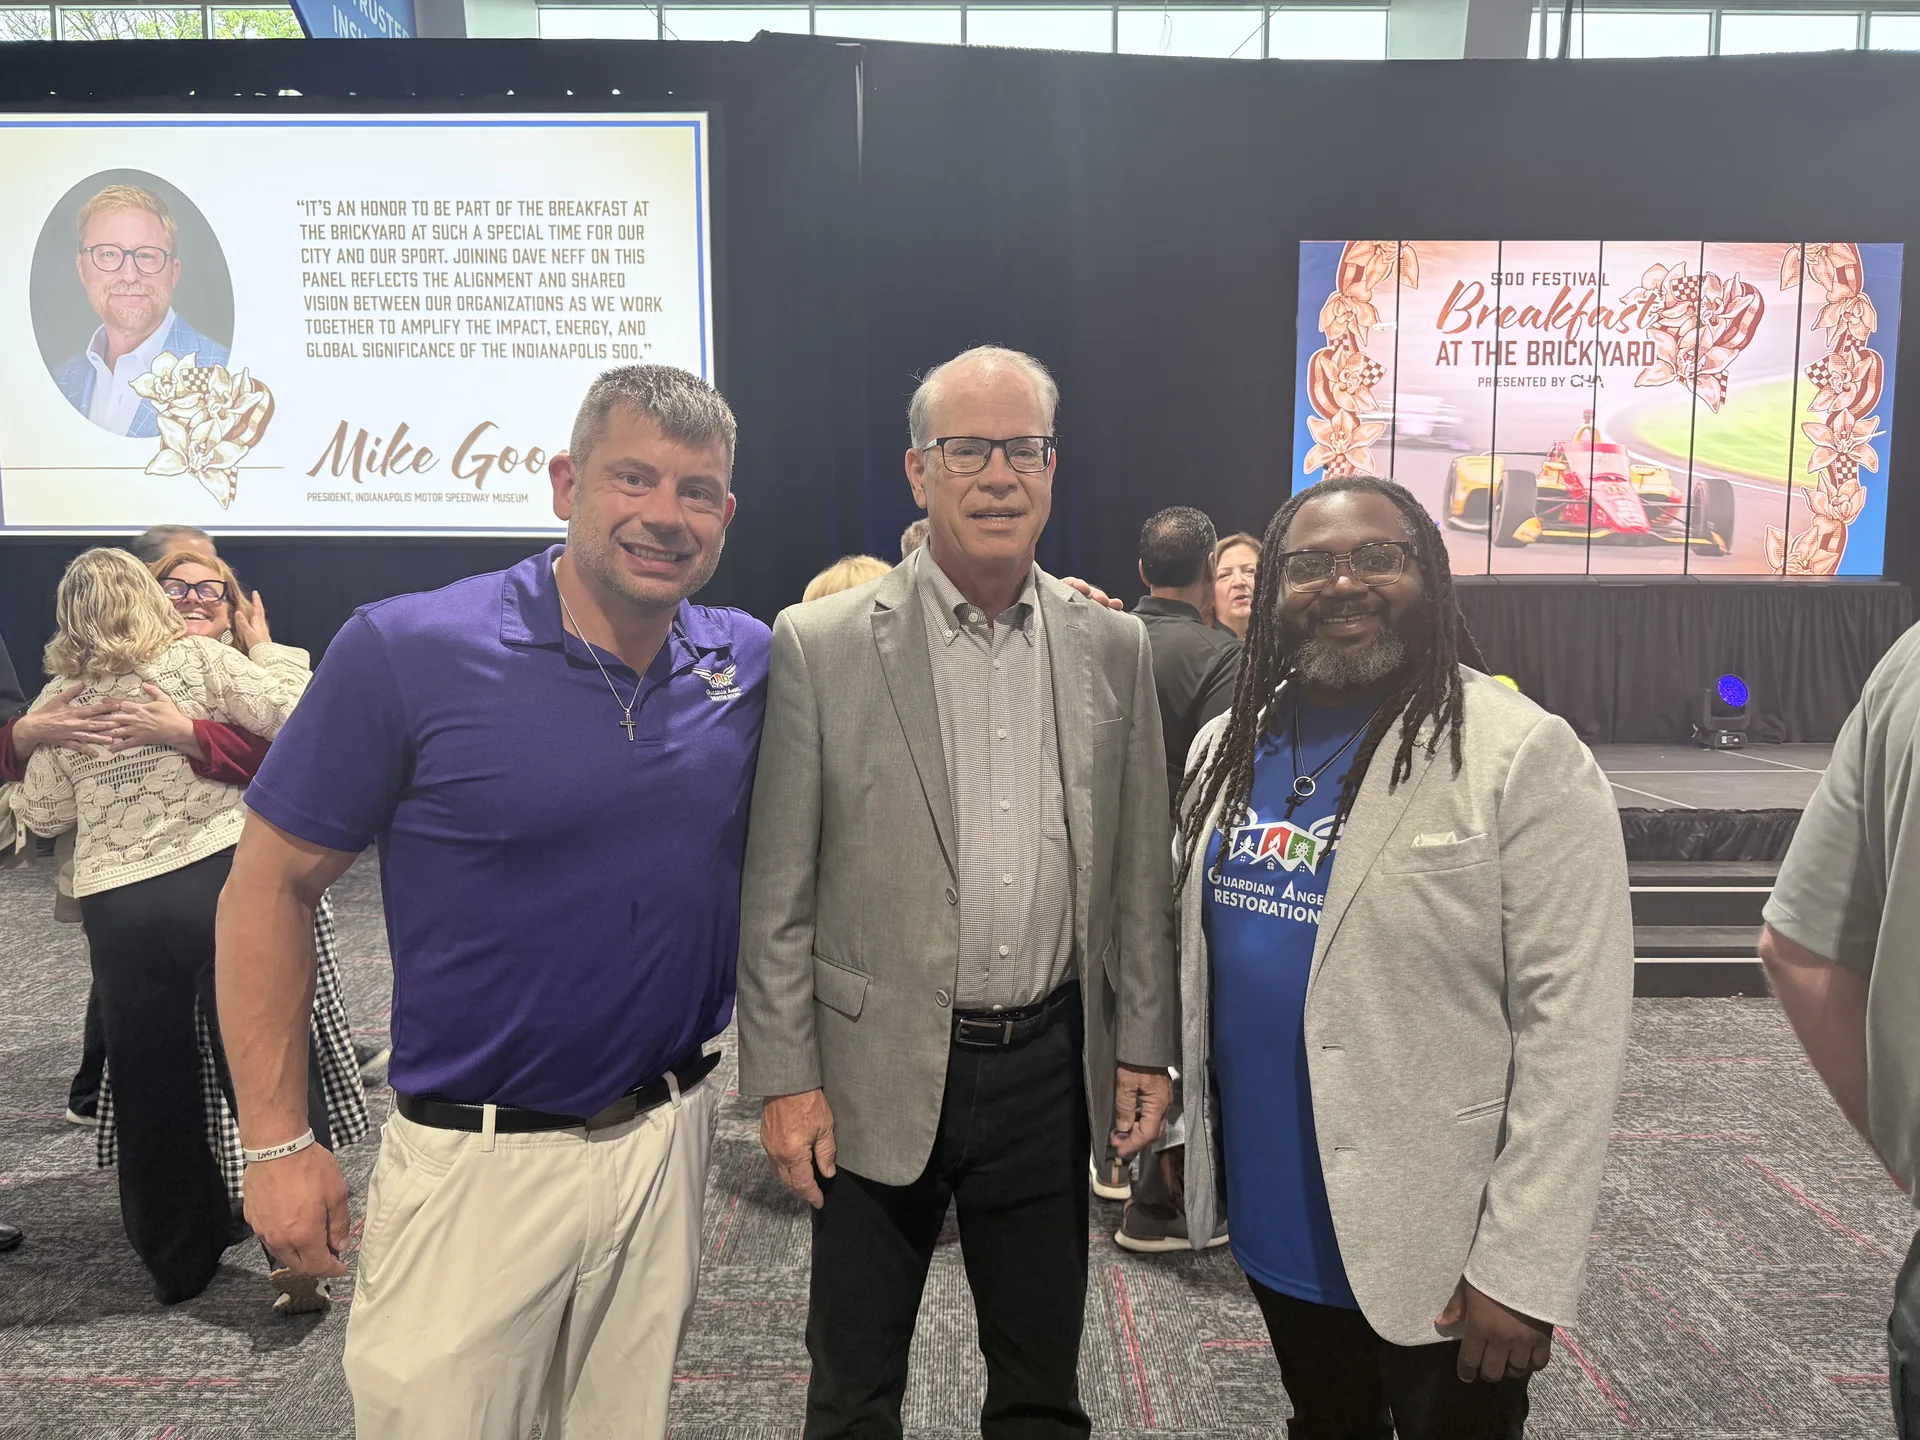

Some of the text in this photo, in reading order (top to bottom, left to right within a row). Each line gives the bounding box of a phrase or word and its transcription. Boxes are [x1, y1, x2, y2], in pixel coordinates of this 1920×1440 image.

[336, 199, 356, 217] AN
[360, 199, 407, 217] HONOR
[411, 200, 429, 217] TO
[433, 199, 452, 217] BE
[455, 199, 492, 217] PART
[495, 200, 513, 217] OF
[516, 199, 544, 217] THE
[548, 200, 629, 217] BREAKFAST
[633, 199, 650, 217] AT
[299, 223, 645, 241] THE BRICKYARD AT SUCH A SPECIAL TIME FOR OUR
[300, 247, 645, 265] CITY AND OUR SPORT. JOINING DAVE NEFF ON THIS
[302, 271, 626, 289] PANEL REFLECTS THE ALIGNMENT AND SHARED
[1490, 272, 1610, 286] 500 FESTIVAL
[303, 294, 664, 313] VISION BETWEEN OUR ORGANIZATIONS AS WE WORK
[1436, 279, 1660, 341] Breakfast
[304, 318, 646, 338] TOGETHER TO AMPLIFY THE IMPACT, ENERGY, AND
[305, 341, 359, 359] GLOBAL
[362, 341, 456, 359] SIGNIFICANCE
[459, 342, 477, 359] OF
[480, 342, 508, 359] THE
[511, 342, 607, 360] INDIANAPOLIS
[1435, 340, 1656, 367] AT THE BRICKYARD
[1477, 376, 1547, 388] PRESENTED
[1551, 376, 1566, 387] BY
[305, 419, 550, 490] Mike Goo
[306, 492, 529, 503] PRESIDENT, INDIANAPOLIS MOTOR SPEEDWAY MUSEUM
[1207, 866, 1325, 906] GUARDIAN ANGE
